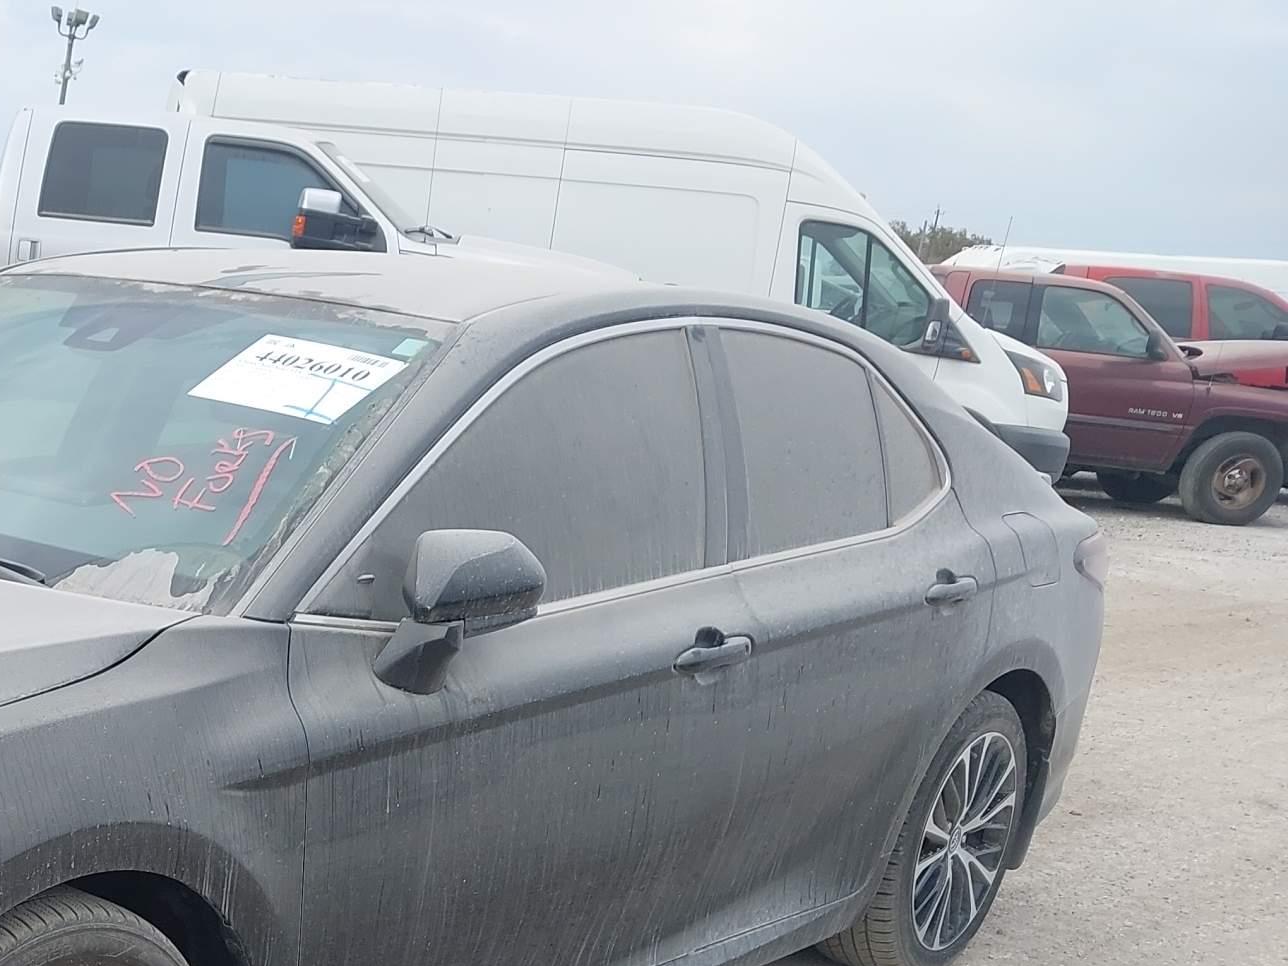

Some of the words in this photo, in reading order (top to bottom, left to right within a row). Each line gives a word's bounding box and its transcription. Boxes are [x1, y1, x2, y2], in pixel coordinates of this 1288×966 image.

[255, 350, 371, 382] 44026010
[1127, 407, 1145, 415] RAM
[110, 456, 185, 519] NO
